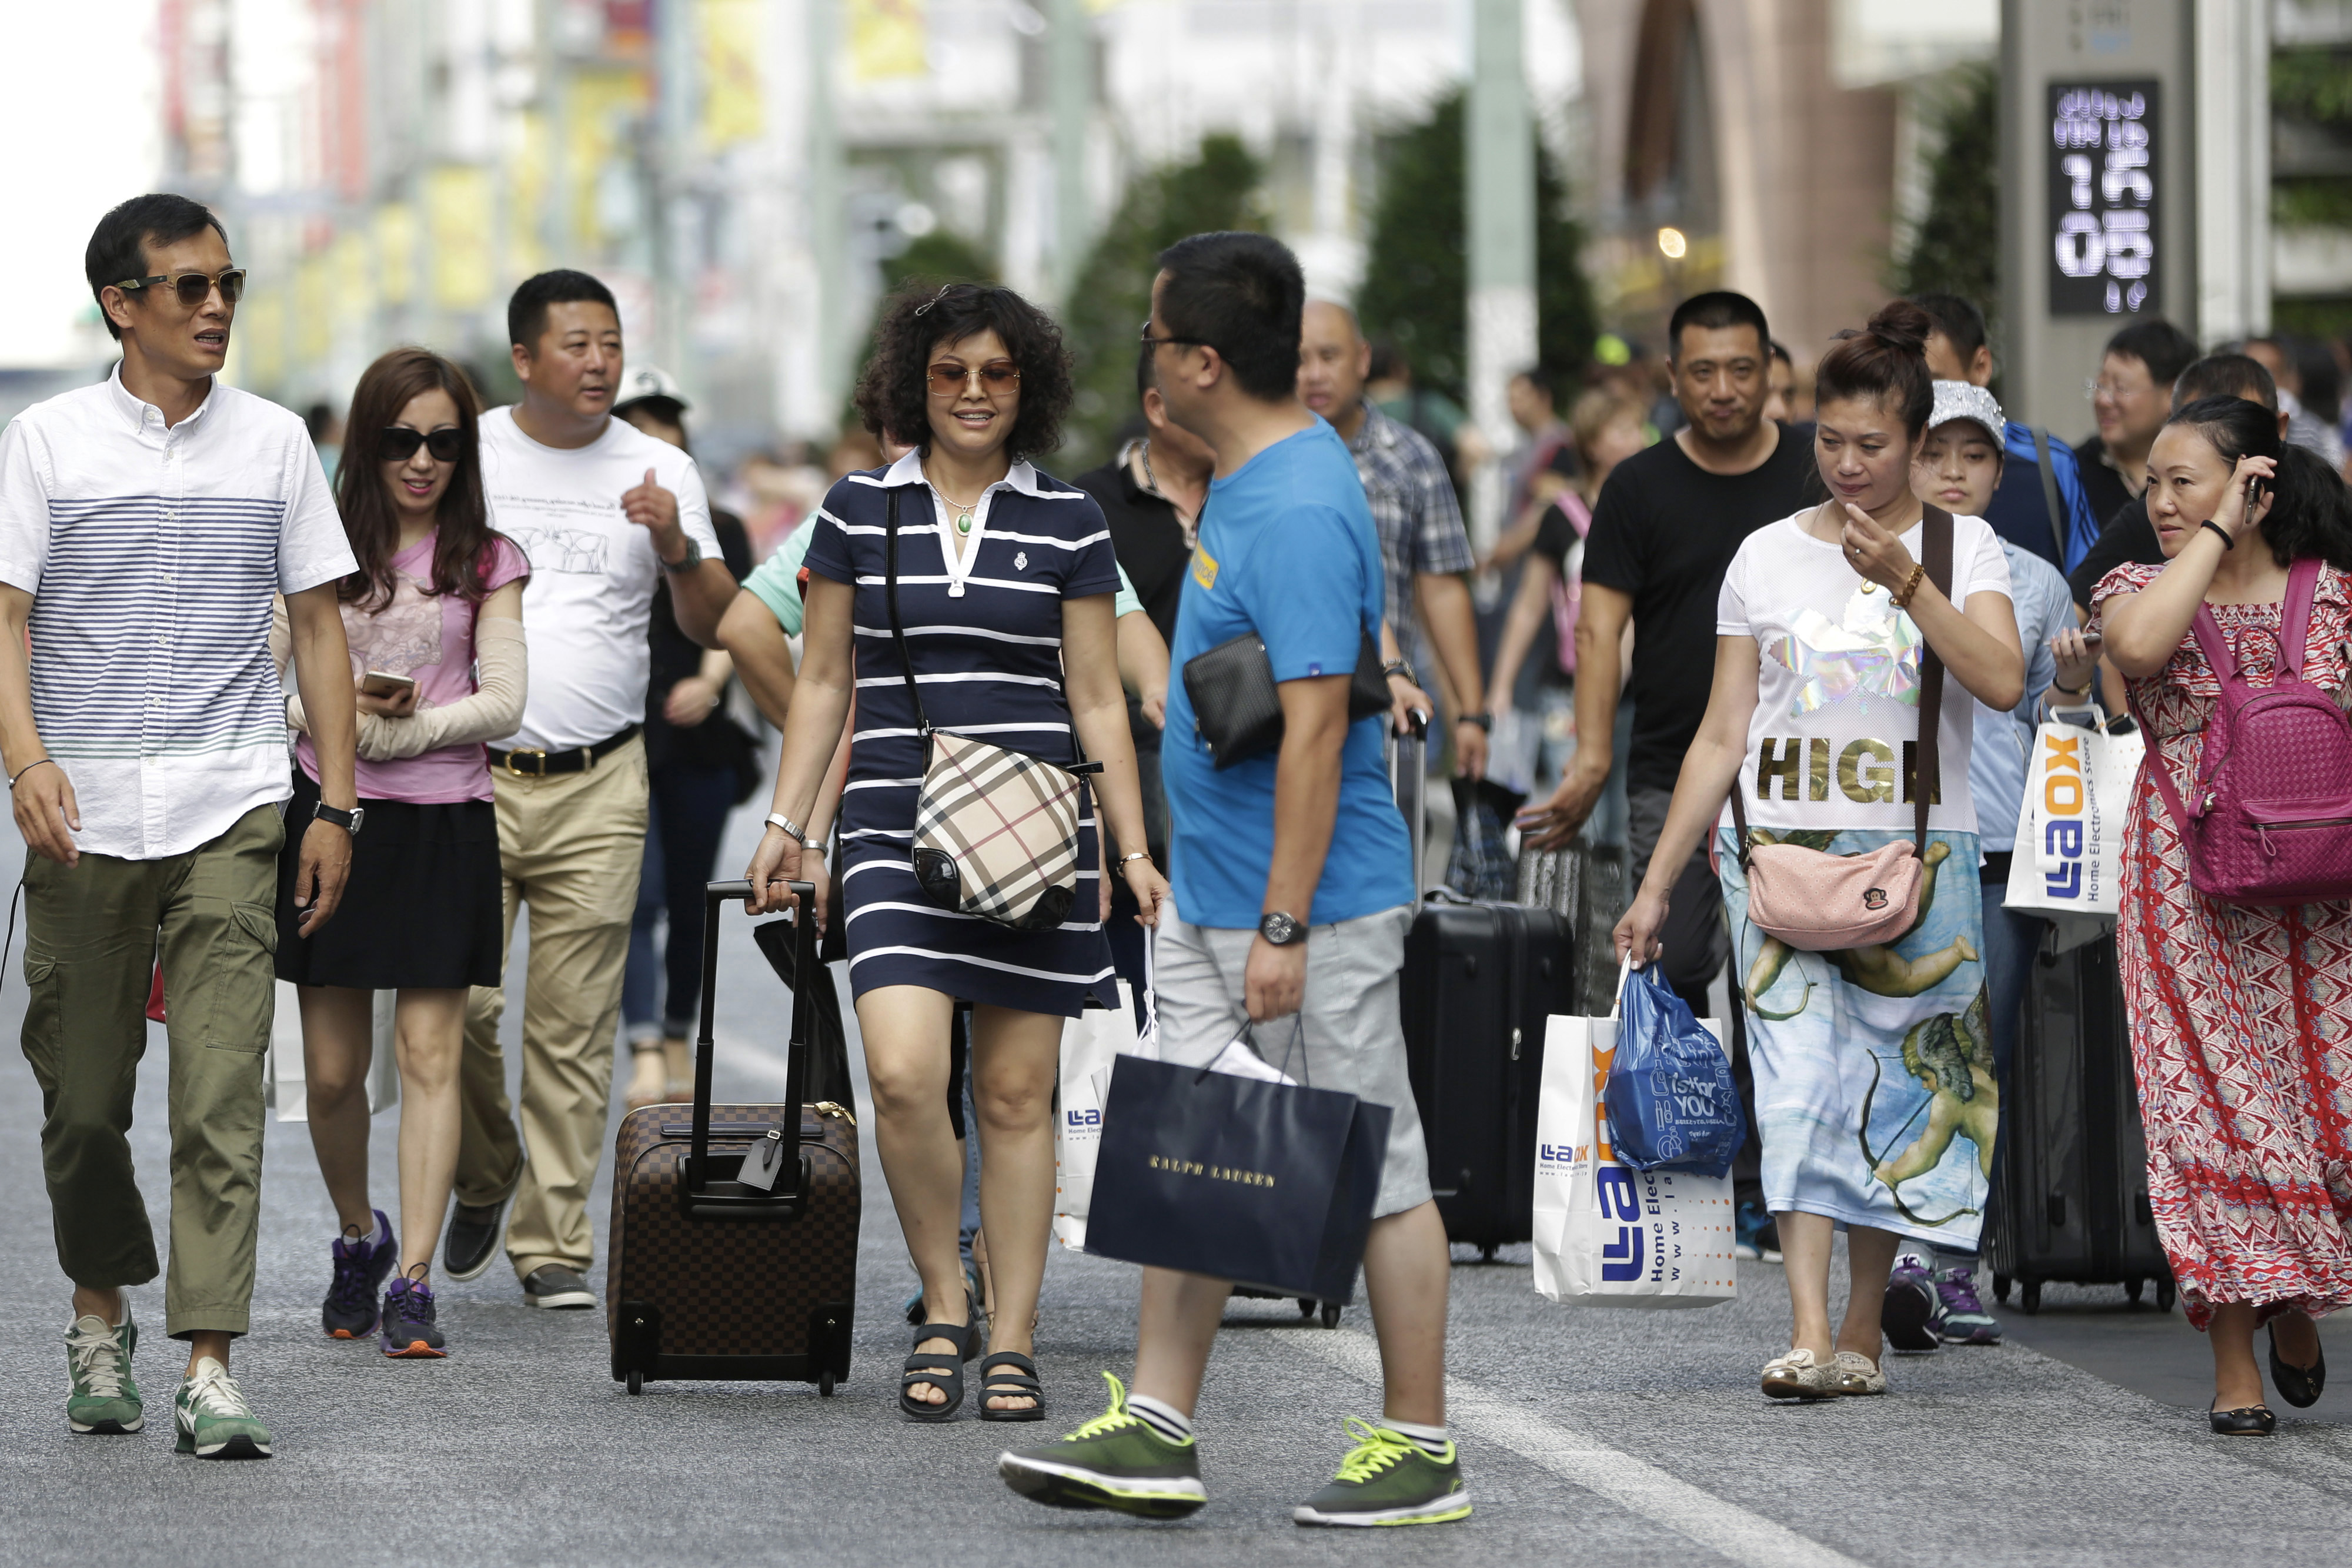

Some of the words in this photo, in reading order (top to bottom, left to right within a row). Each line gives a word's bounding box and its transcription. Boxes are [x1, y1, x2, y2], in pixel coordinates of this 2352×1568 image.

[2087, 778, 2100, 855] Electronics
[2087, 860, 2100, 902] Home
[1673, 1095, 1716, 1117] YOU
[1149, 1154, 1204, 1176] RALPH
[1209, 1164, 1276, 1188] LAUREN
[1651, 1222, 1665, 1282] Home
